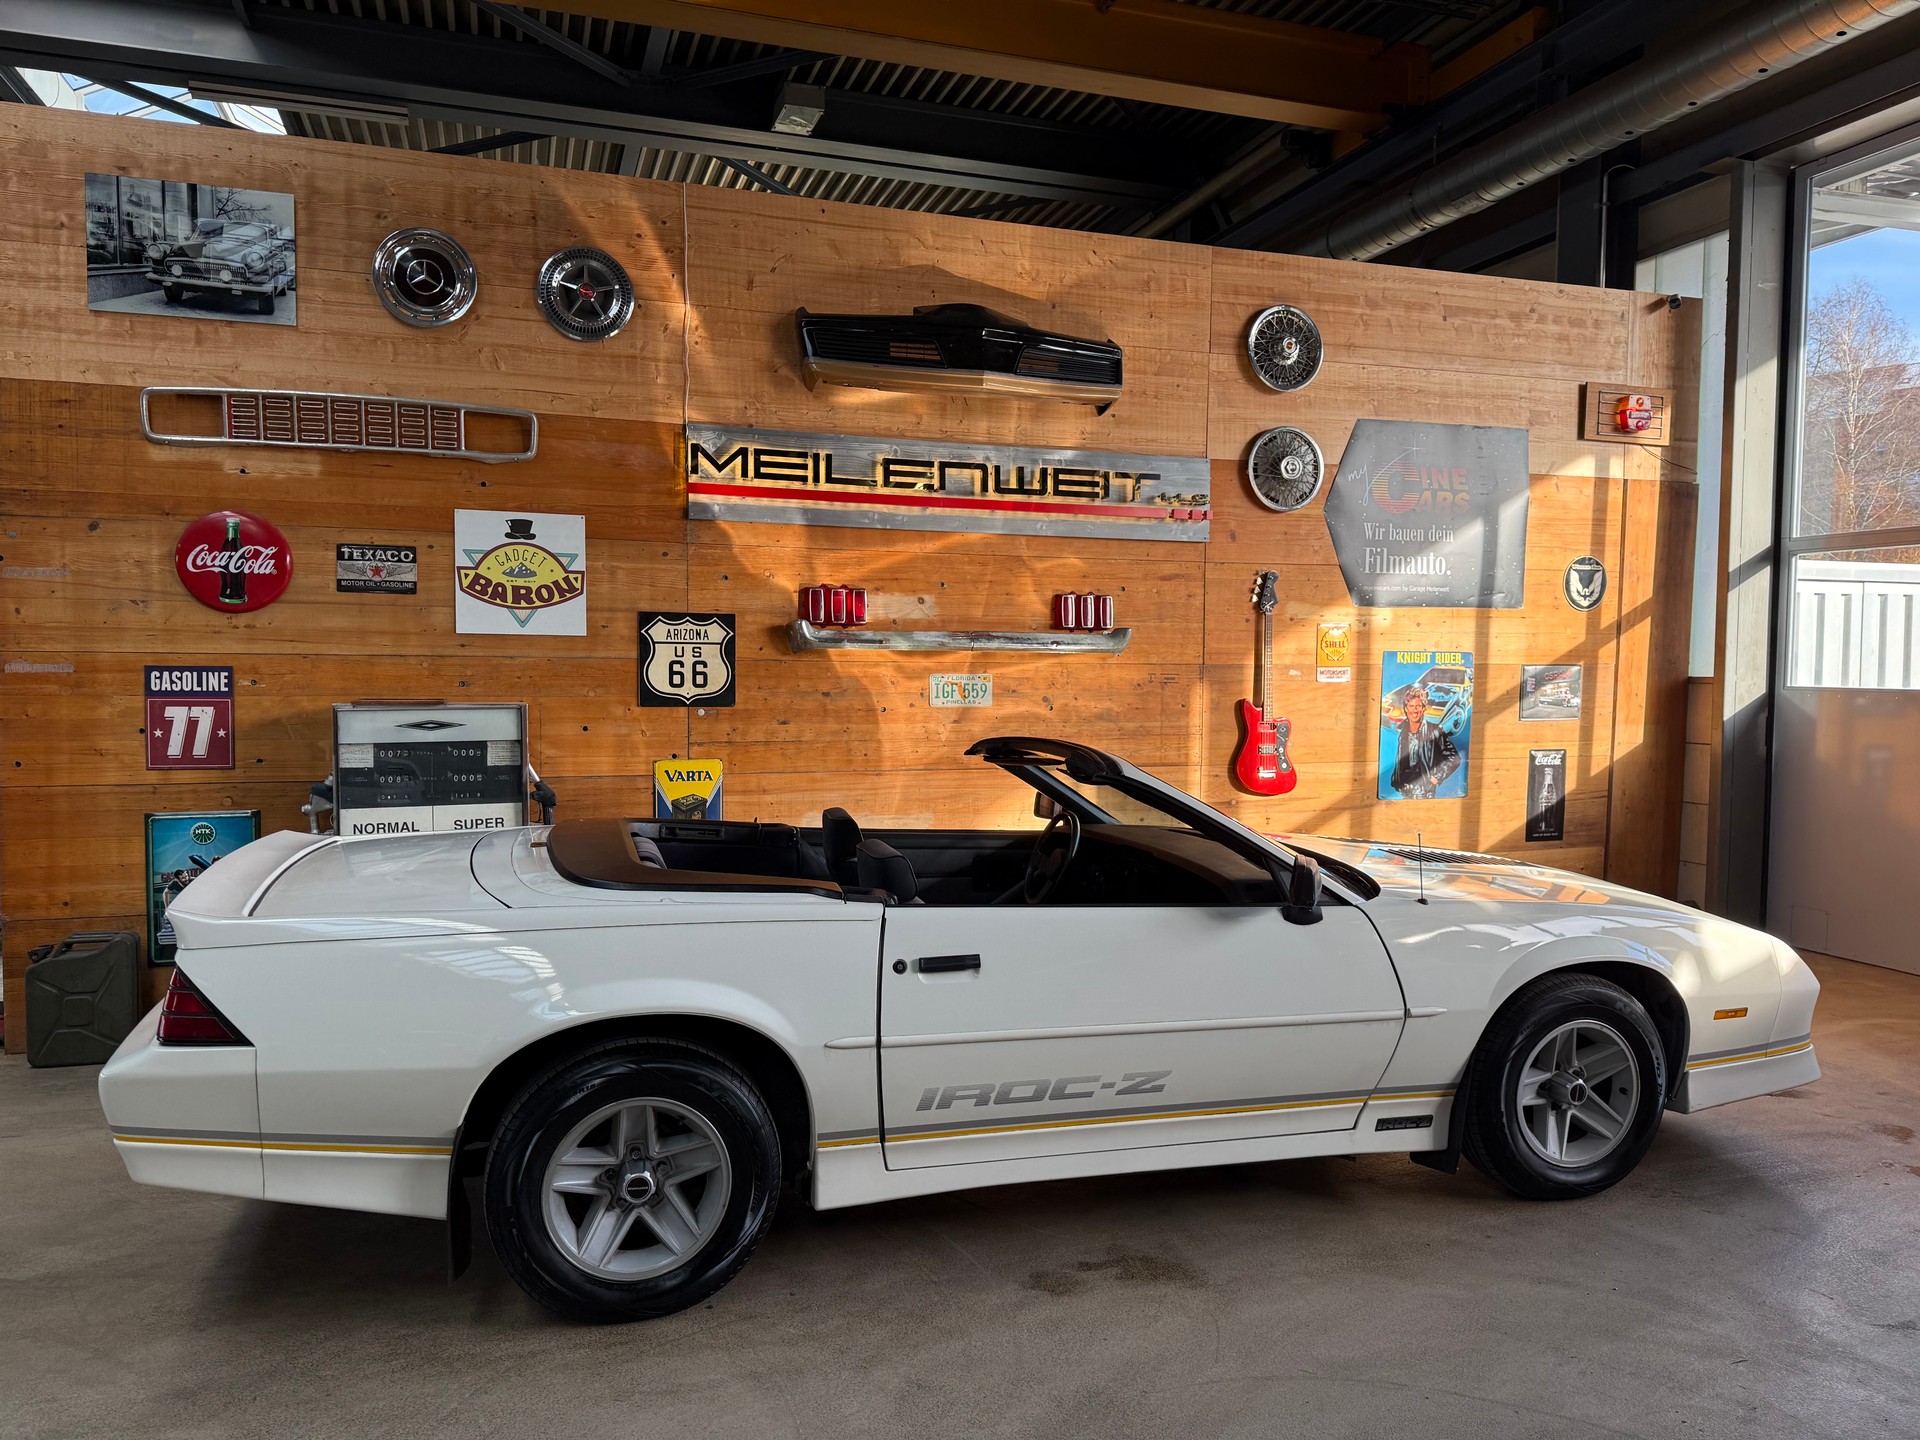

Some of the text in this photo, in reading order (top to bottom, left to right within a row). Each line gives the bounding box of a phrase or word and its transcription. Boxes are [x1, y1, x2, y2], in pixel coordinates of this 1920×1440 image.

[1348, 463, 1369, 506] my
[1363, 522, 1454, 542] Wir bauen dein
[186, 543, 279, 575] Coca-Cola
[340, 547, 414, 562] TEXACO
[494, 548, 548, 567] GADGET
[1363, 547, 1452, 575] Filmauto.
[380, 581, 415, 589] GASOLINE
[465, 571, 580, 606] BARON
[1401, 583, 1409, 592] by
[665, 628, 710, 641] ARIZONA
[1324, 640, 1346, 649] SHELL
[1396, 651, 1433, 664] KNIGHT
[150, 671, 229, 692] GASOLINE
[668, 660, 708, 689] 66
[934, 682, 988, 699] IGF 559
[164, 706, 216, 759] 77
[664, 769, 714, 782] VARTA
[353, 821, 420, 835] NORMAL
[453, 817, 505, 830] SUPER
[915, 1069, 1172, 1112] IROC-Z
